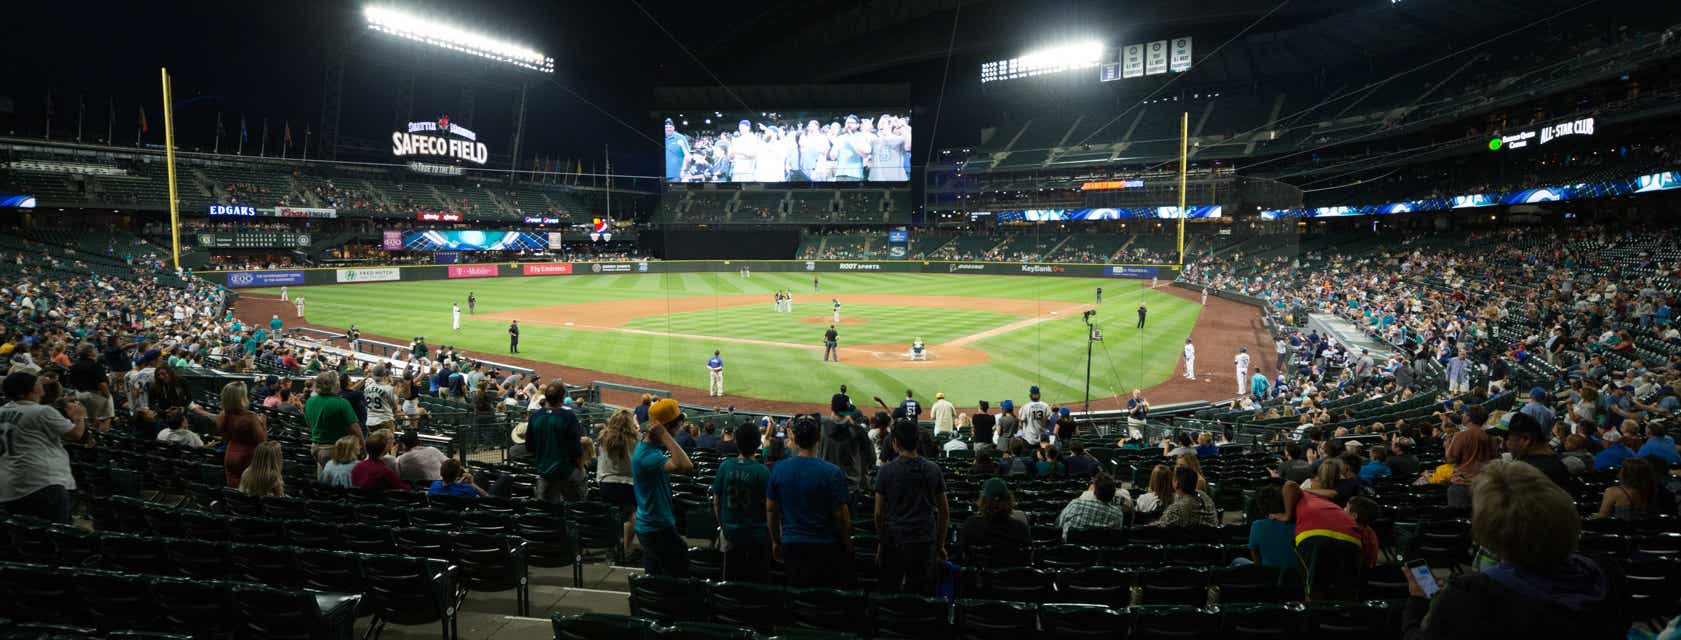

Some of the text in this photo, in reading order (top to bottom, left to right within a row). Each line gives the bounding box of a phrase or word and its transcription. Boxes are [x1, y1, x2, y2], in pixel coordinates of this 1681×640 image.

[1574, 118, 1594, 135] CLUB
[392, 132, 488, 165] SAFECO FIELD
[530, 264, 541, 272] Fly
[907, 406, 916, 416] 51
